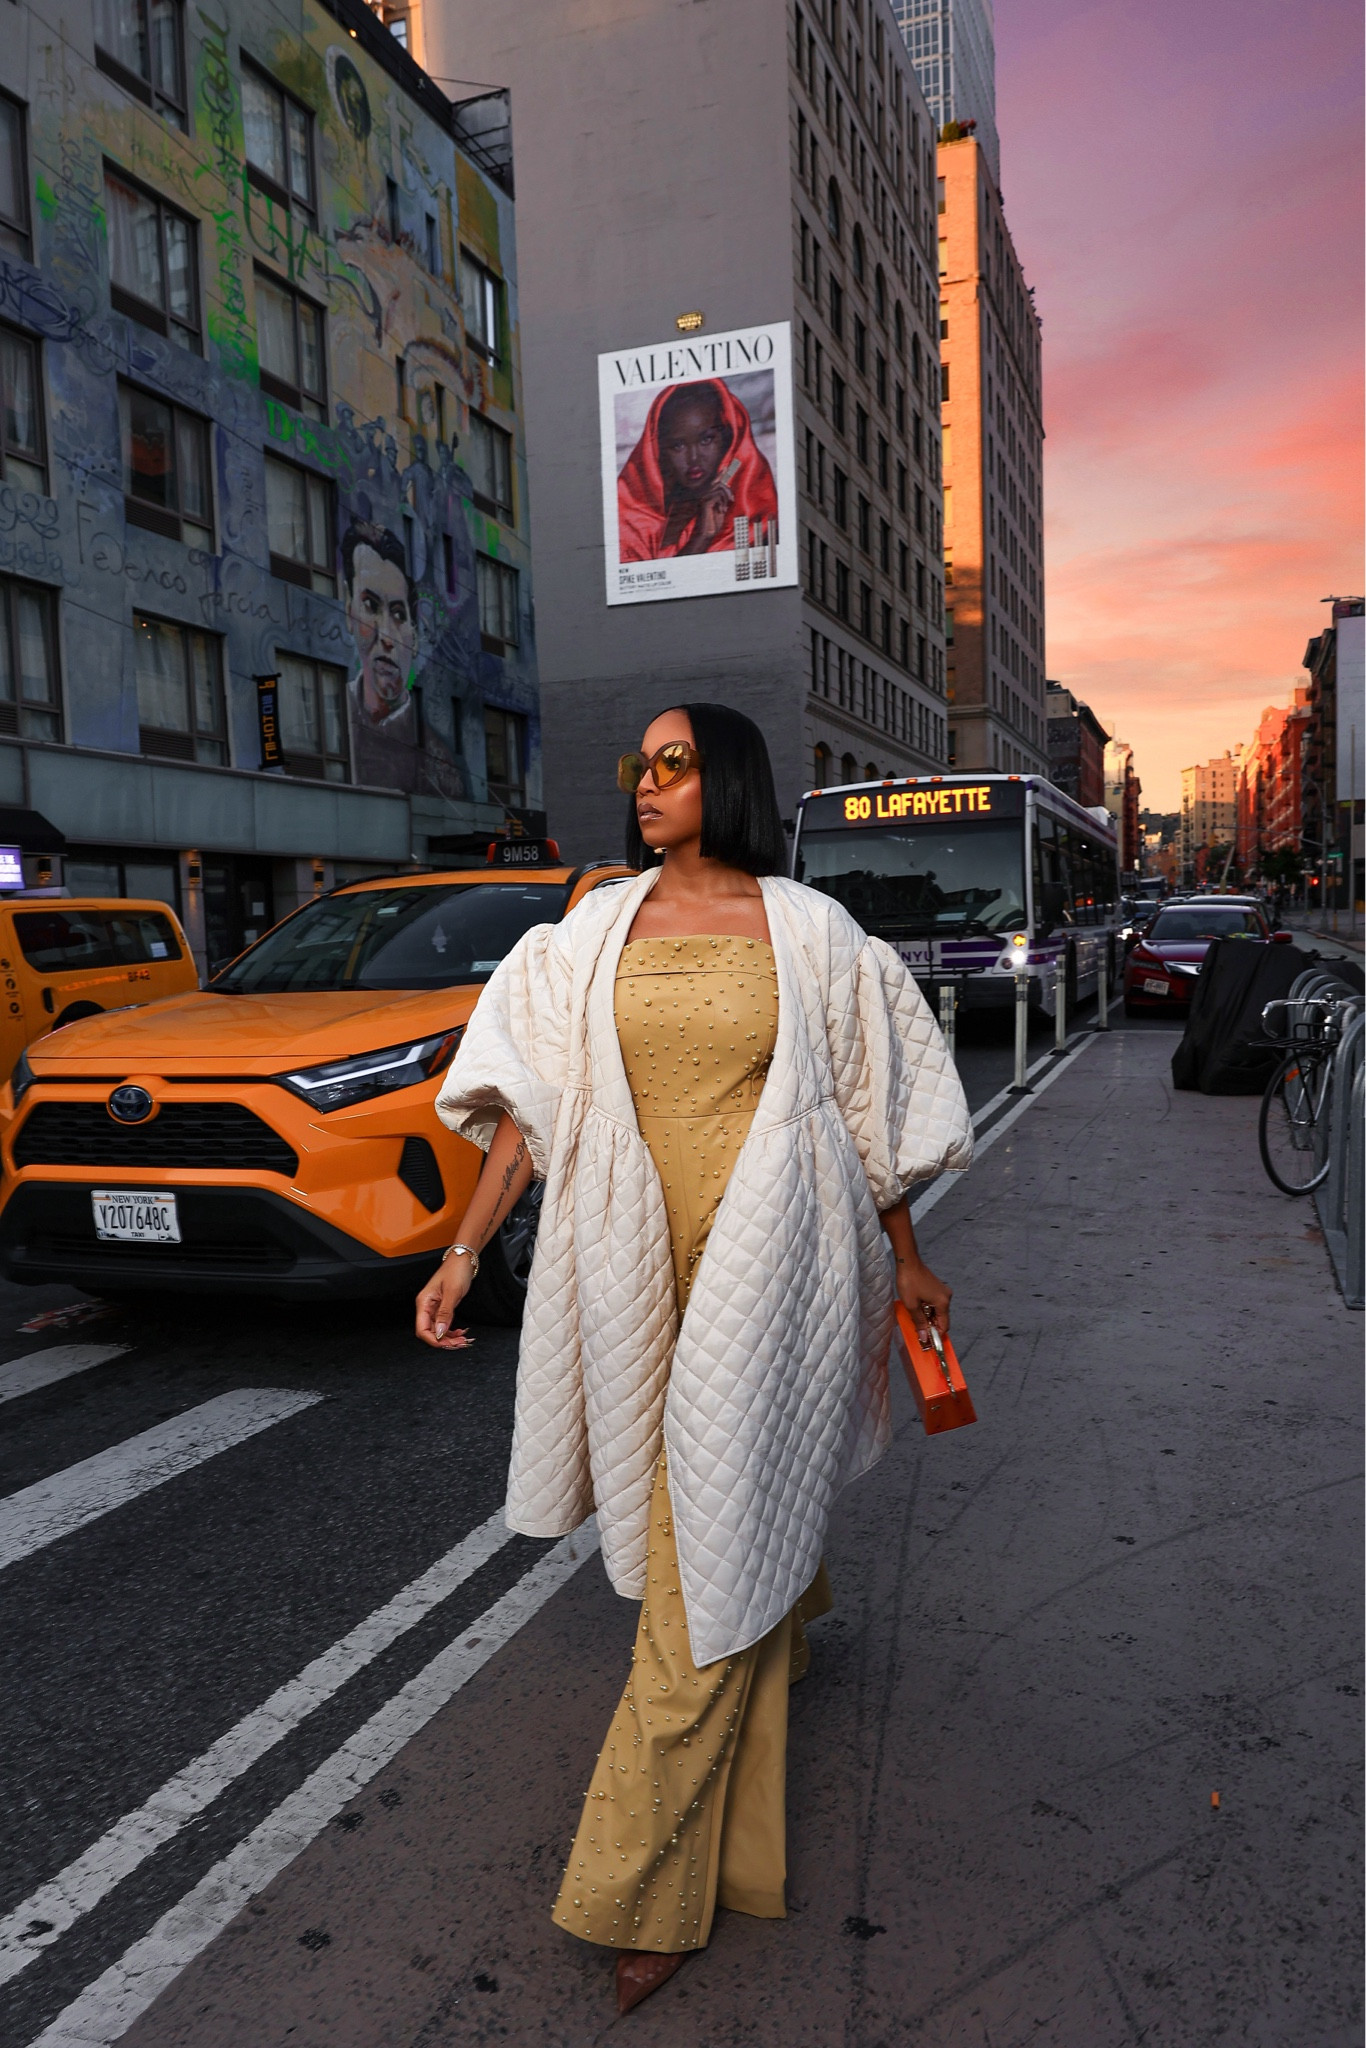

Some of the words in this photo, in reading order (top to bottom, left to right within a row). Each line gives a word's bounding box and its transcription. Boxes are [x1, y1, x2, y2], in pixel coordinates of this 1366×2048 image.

[615, 335, 774, 386] VALENTINO
[844, 796, 872, 821] 80
[876, 786, 992, 818] LAFAYETTE
[503, 845, 539, 863] 9M58
[901, 950, 935, 963] NYU
[112, 1195, 131, 1204] NEW
[132, 1196, 154, 1205] YORK
[99, 1204, 171, 1231] Y207648C
